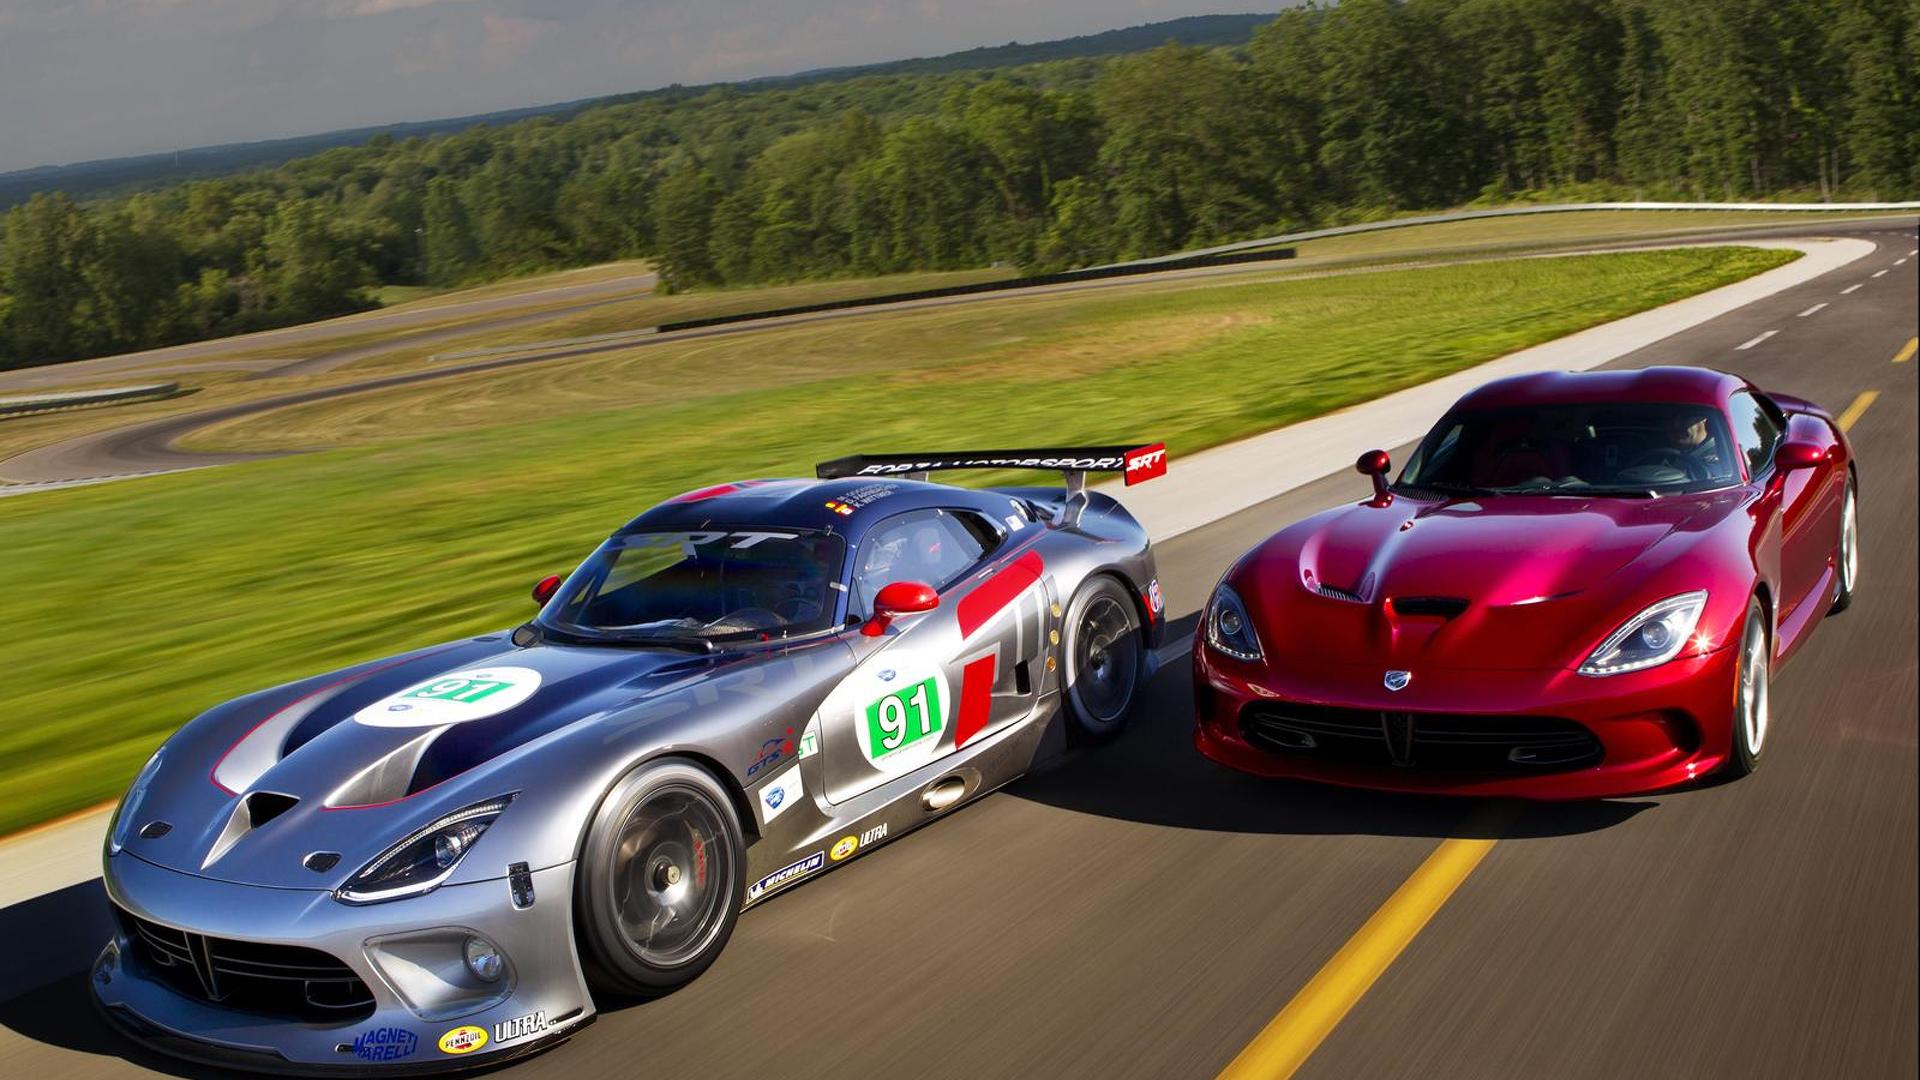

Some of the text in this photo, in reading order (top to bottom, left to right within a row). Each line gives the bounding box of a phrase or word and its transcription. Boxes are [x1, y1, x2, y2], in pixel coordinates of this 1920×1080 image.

[857, 457, 1124, 475] FOR ORSPORT
[1126, 449, 1166, 472] SRT
[415, 678, 501, 702] 91
[877, 682, 932, 751] 91
[859, 823, 888, 848] ULTRA
[764, 856, 821, 888] MICHELIN
[493, 1011, 548, 1044] ULTRA
[445, 1032, 481, 1049] PENNZOIL
